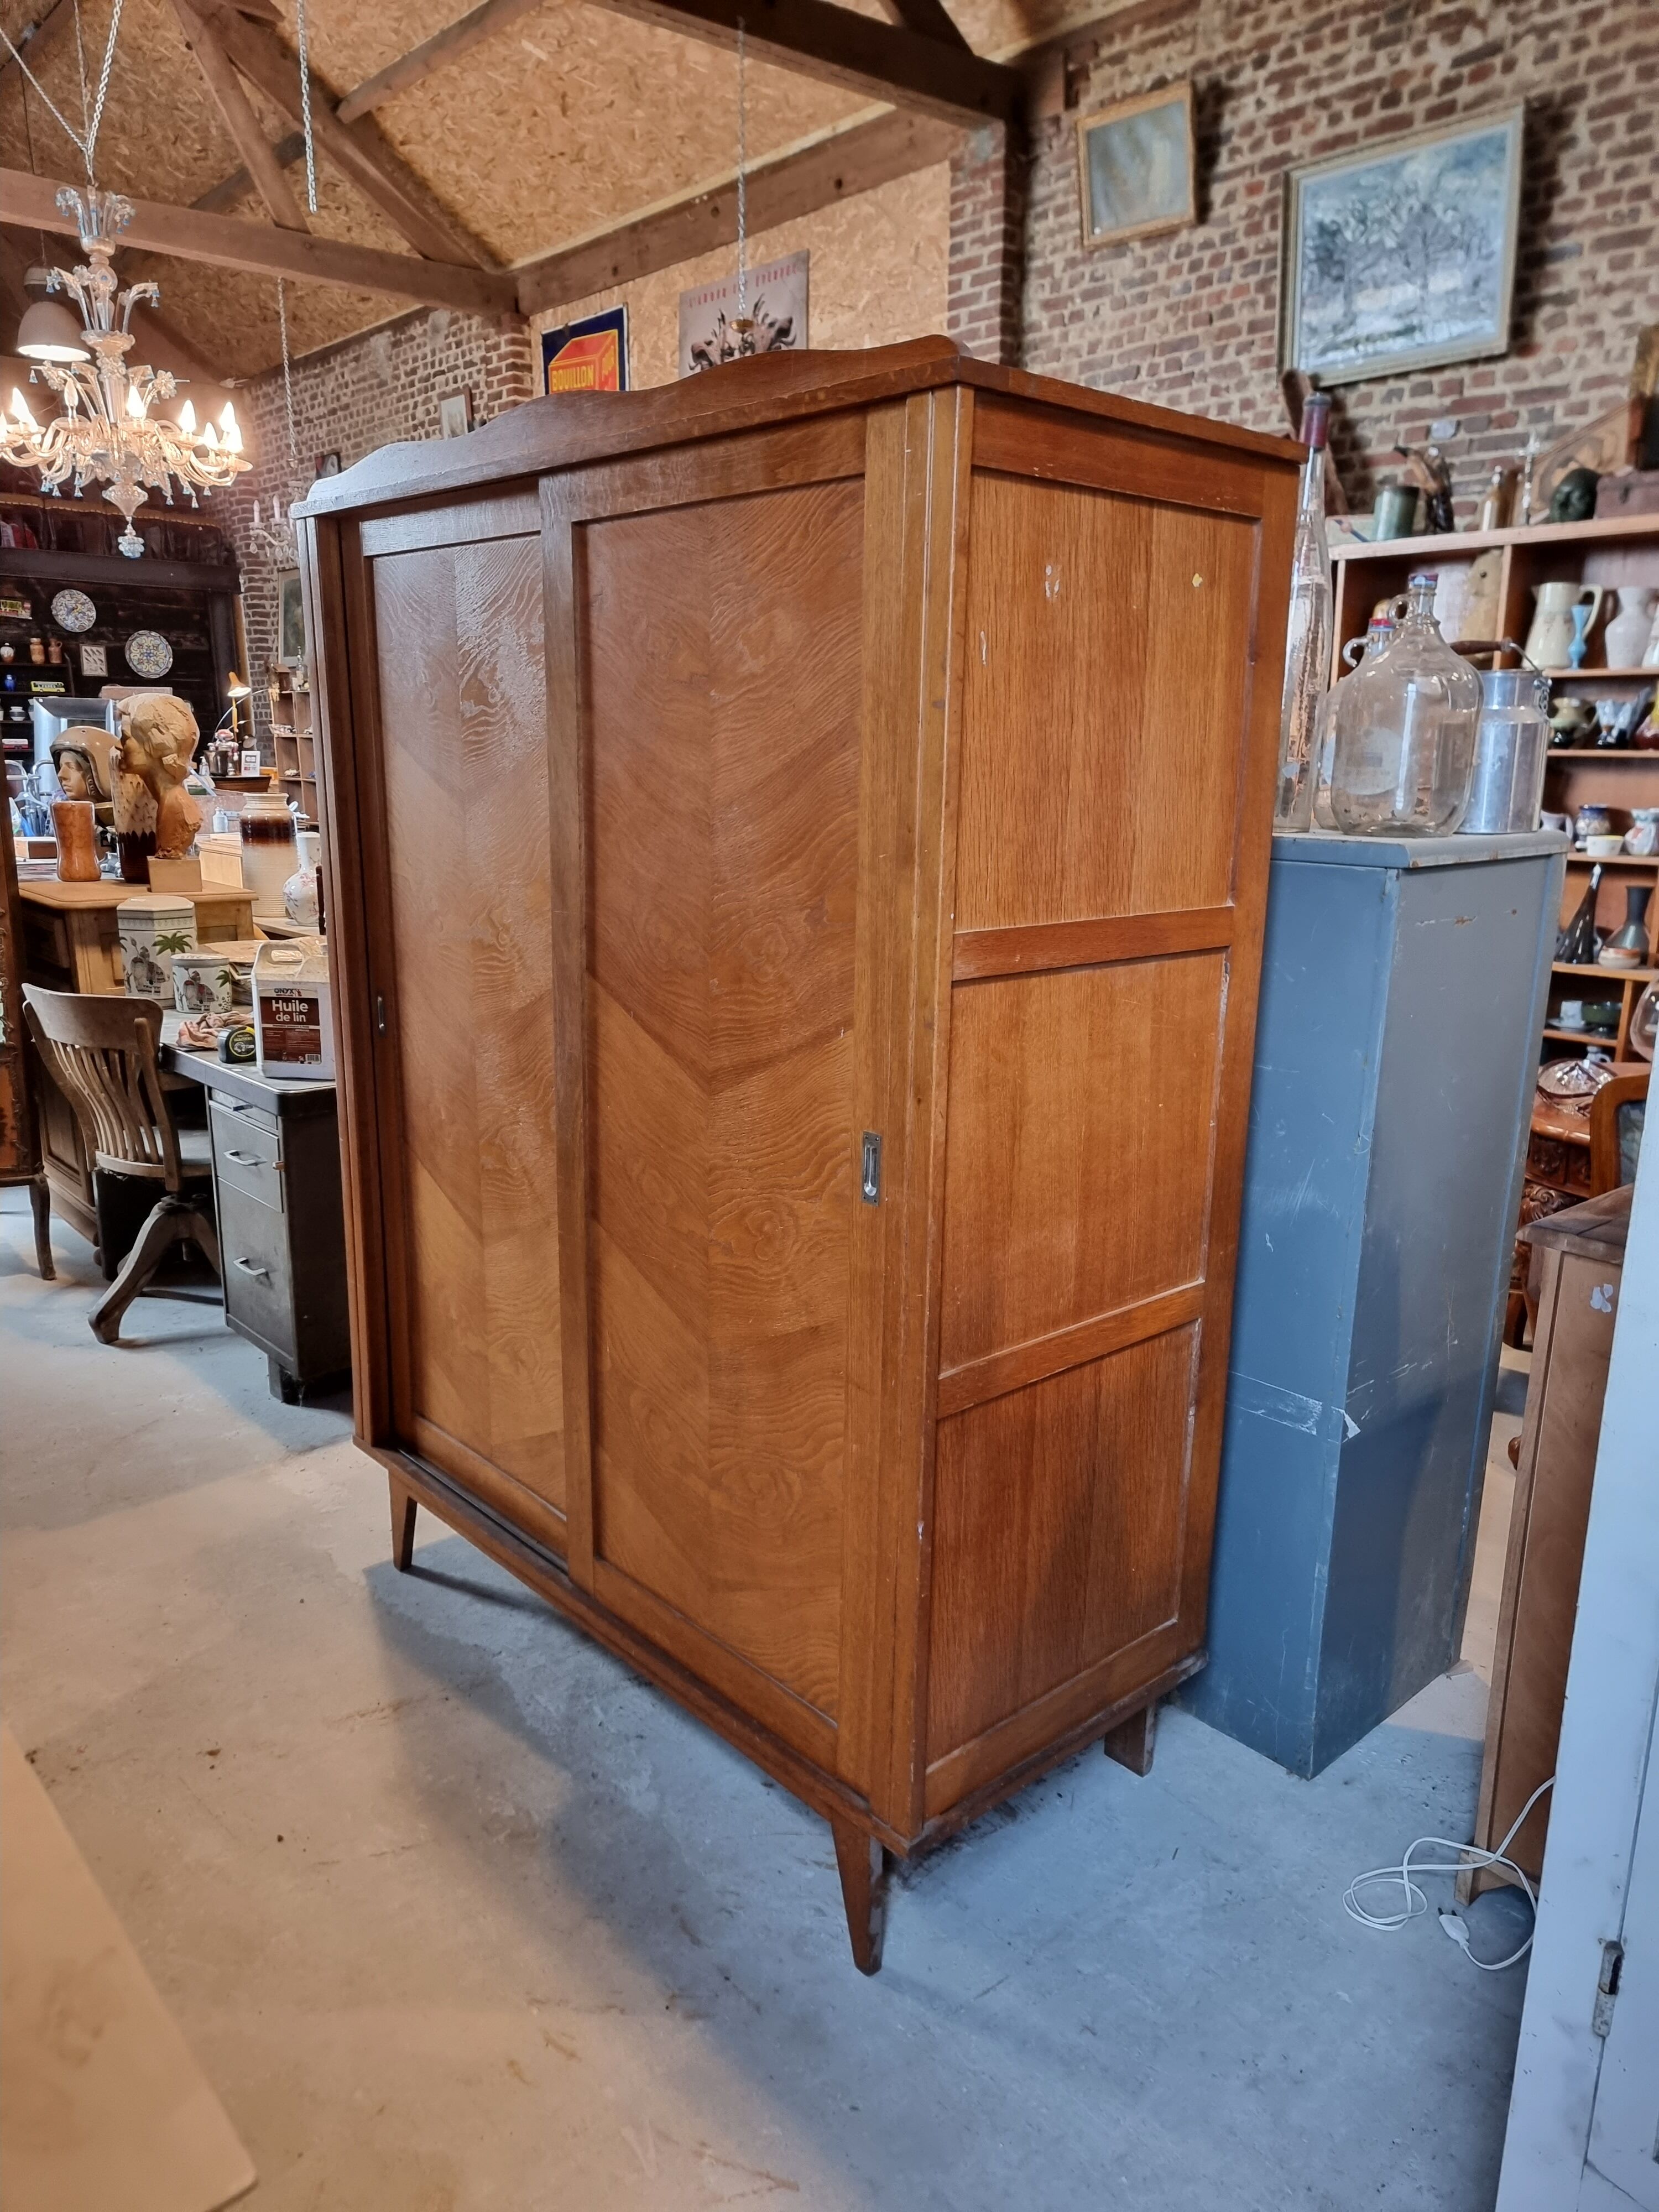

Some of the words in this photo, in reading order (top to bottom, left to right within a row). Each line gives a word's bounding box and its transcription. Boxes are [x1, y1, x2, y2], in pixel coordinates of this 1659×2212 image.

[551, 365, 594, 391] BOUILLON
[272, 999, 309, 1012] Huile
[275, 1012, 290, 1021] de
[293, 1013, 306, 1022] lin
